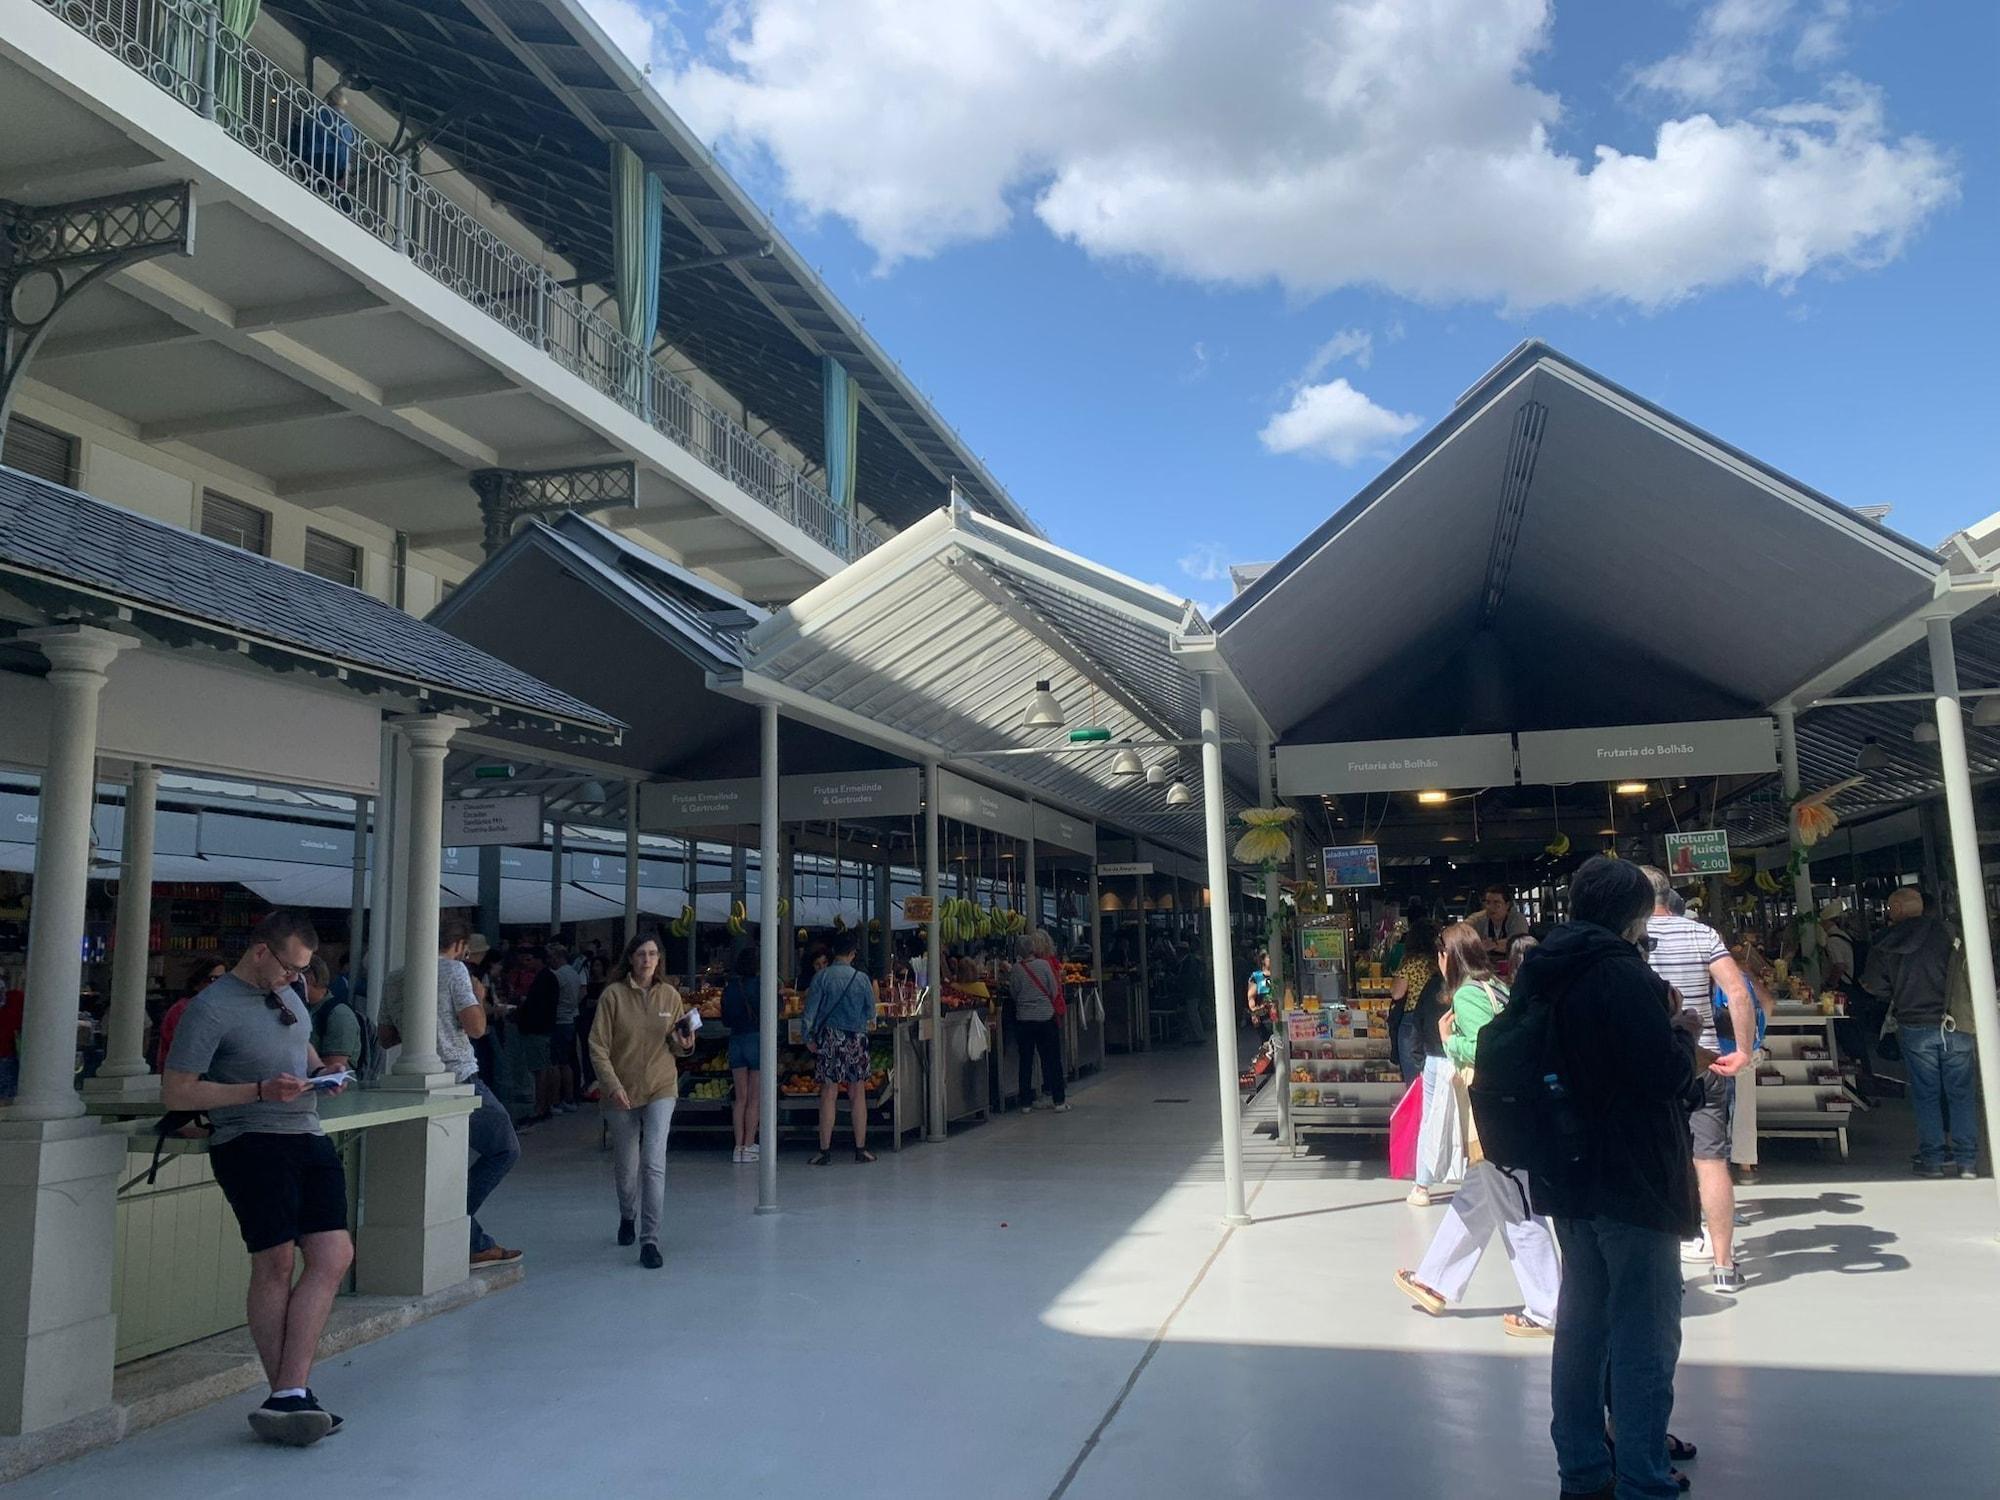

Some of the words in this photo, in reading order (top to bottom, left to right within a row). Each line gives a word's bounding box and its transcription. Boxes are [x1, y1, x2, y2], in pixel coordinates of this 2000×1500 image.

[1597, 747, 1637, 759] Frutaria
[1640, 746, 1653, 757] do
[1657, 742, 1694, 756] Bolhão
[1348, 761, 1387, 772] Frutaria
[1389, 760, 1401, 770] do
[1404, 757, 1439, 770] Bolhão
[813, 785, 838, 796] Frutas
[839, 782, 882, 794] Ermelinda
[671, 794, 696, 804] Frutas
[697, 791, 739, 803] Ermelinda
[822, 796, 830, 806] &
[831, 794, 873, 805] Gertrudes
[681, 804, 688, 813] &
[689, 802, 729, 813] Gertrudes
[1670, 832, 1718, 845] Natural
